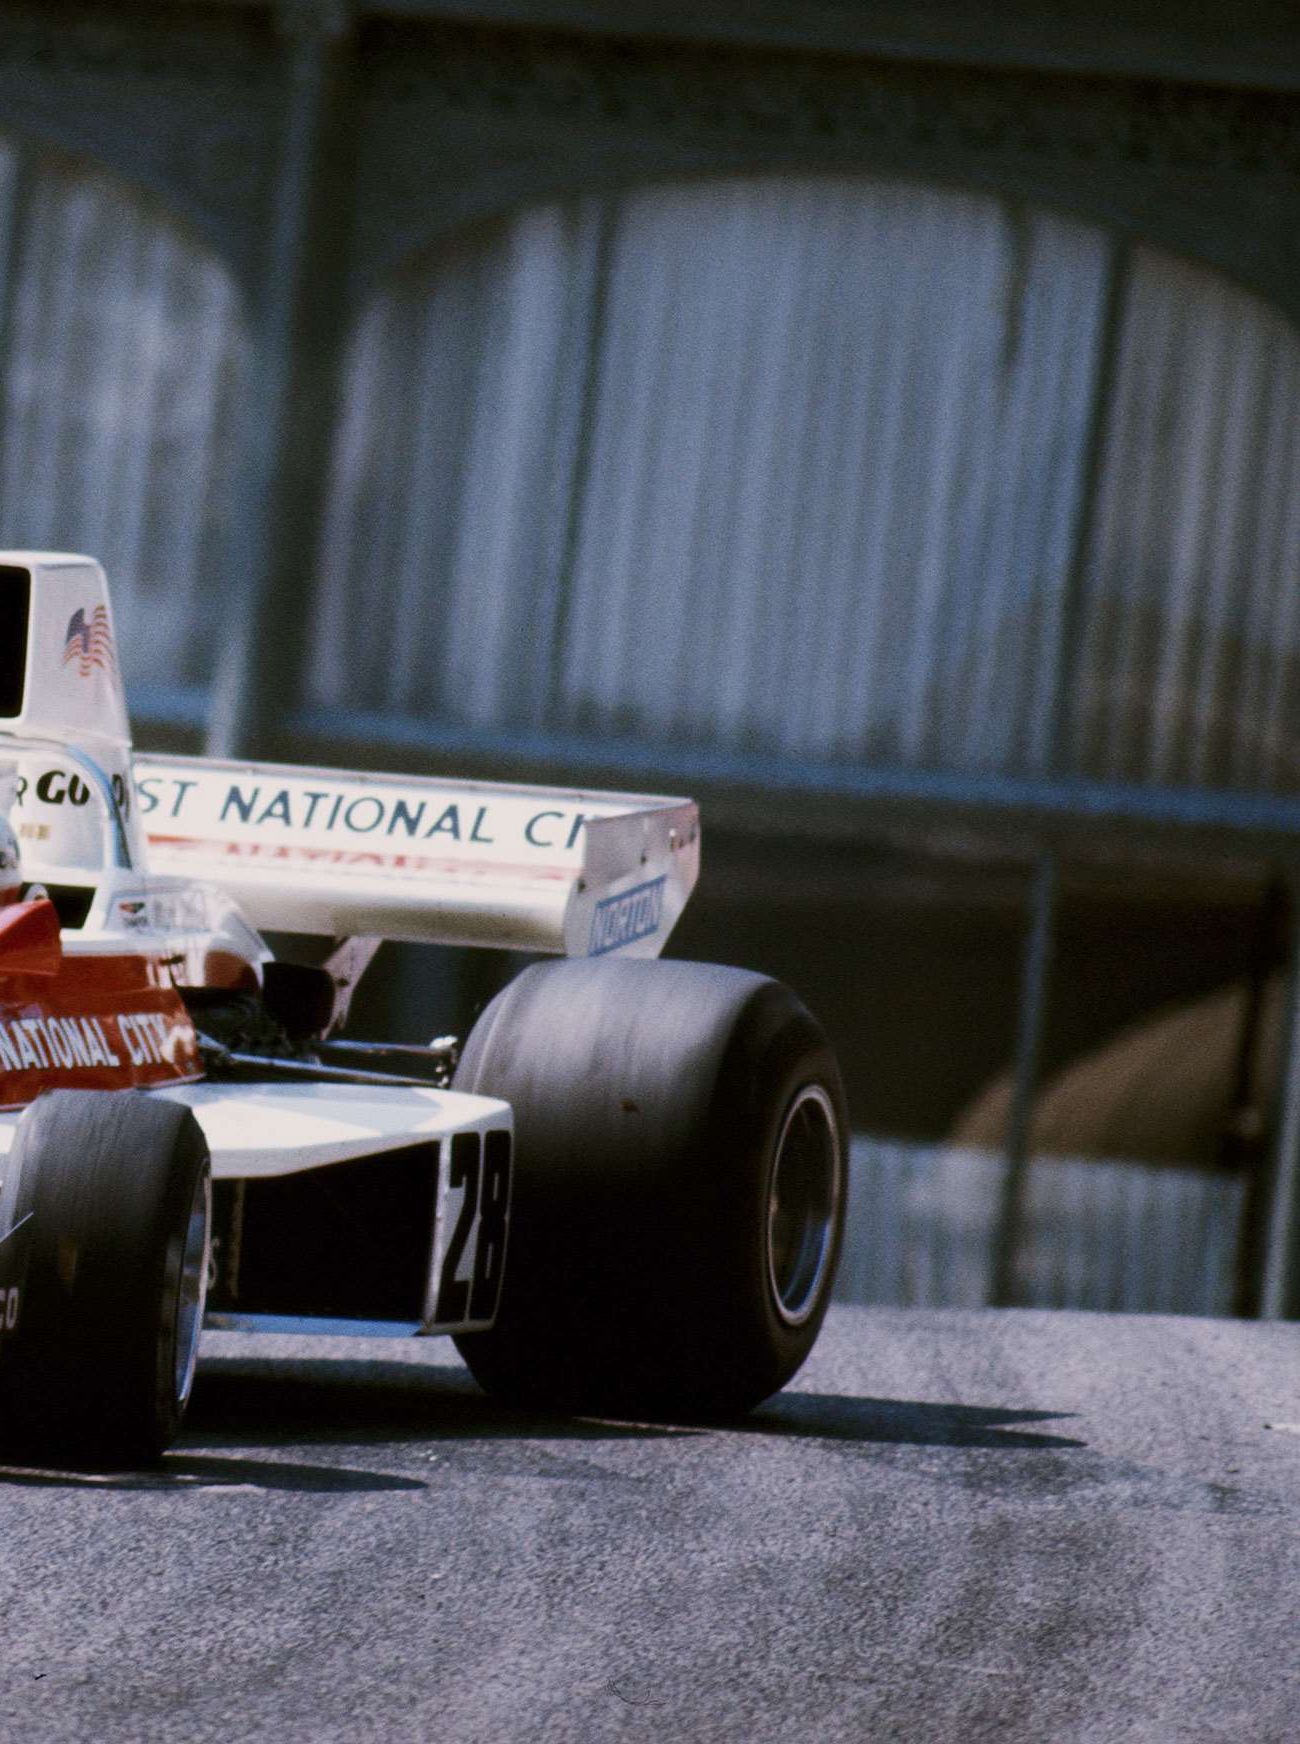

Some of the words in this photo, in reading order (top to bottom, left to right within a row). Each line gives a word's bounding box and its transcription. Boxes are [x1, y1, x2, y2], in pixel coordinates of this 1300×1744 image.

[219, 784, 494, 845] NATIONAL
[116, 1012, 171, 1067] CITY
[434, 1129, 512, 1324] 28
